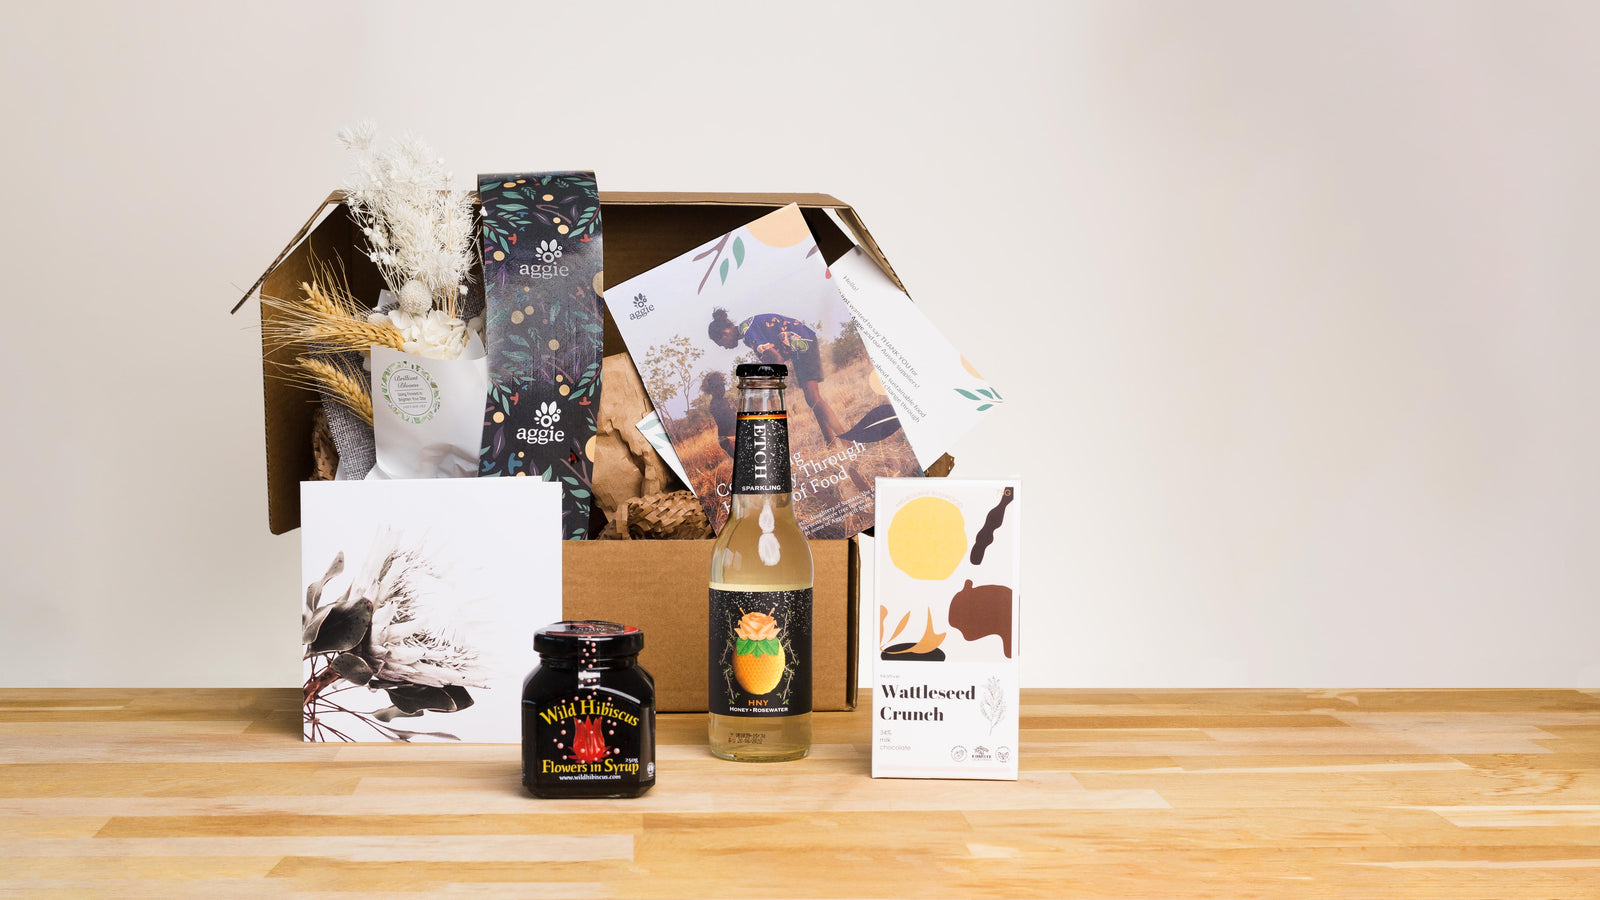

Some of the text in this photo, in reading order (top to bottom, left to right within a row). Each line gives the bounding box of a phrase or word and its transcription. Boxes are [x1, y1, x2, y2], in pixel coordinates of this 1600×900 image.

[520, 262, 569, 280] aggie
[844, 276, 859, 292] Hello!
[630, 304, 655, 320] aggie
[849, 304, 867, 322] wanted
[881, 336, 899, 356] THANK
[898, 355, 911, 369] YOU
[909, 367, 917, 376] for
[863, 330, 873, 340] and
[881, 348, 897, 366] Aussie
[896, 366, 919, 388] suppliers!
[875, 363, 889, 378] about
[888, 378, 915, 405] sustainable
[913, 404, 926, 418] food
[901, 402, 920, 422] through
[516, 426, 564, 444] aggie
[754, 424, 767, 480] ETCH
[799, 440, 867, 478] Through
[793, 487, 808, 502] of
[810, 466, 850, 494] Food
[882, 684, 975, 700] Wattleseed
[540, 700, 640, 726] Wild Hibiscus
[880, 706, 944, 721] Crunch
[542, 760, 587, 773] Flowers
[590, 762, 602, 772] in
[604, 758, 639, 775] Syrup
